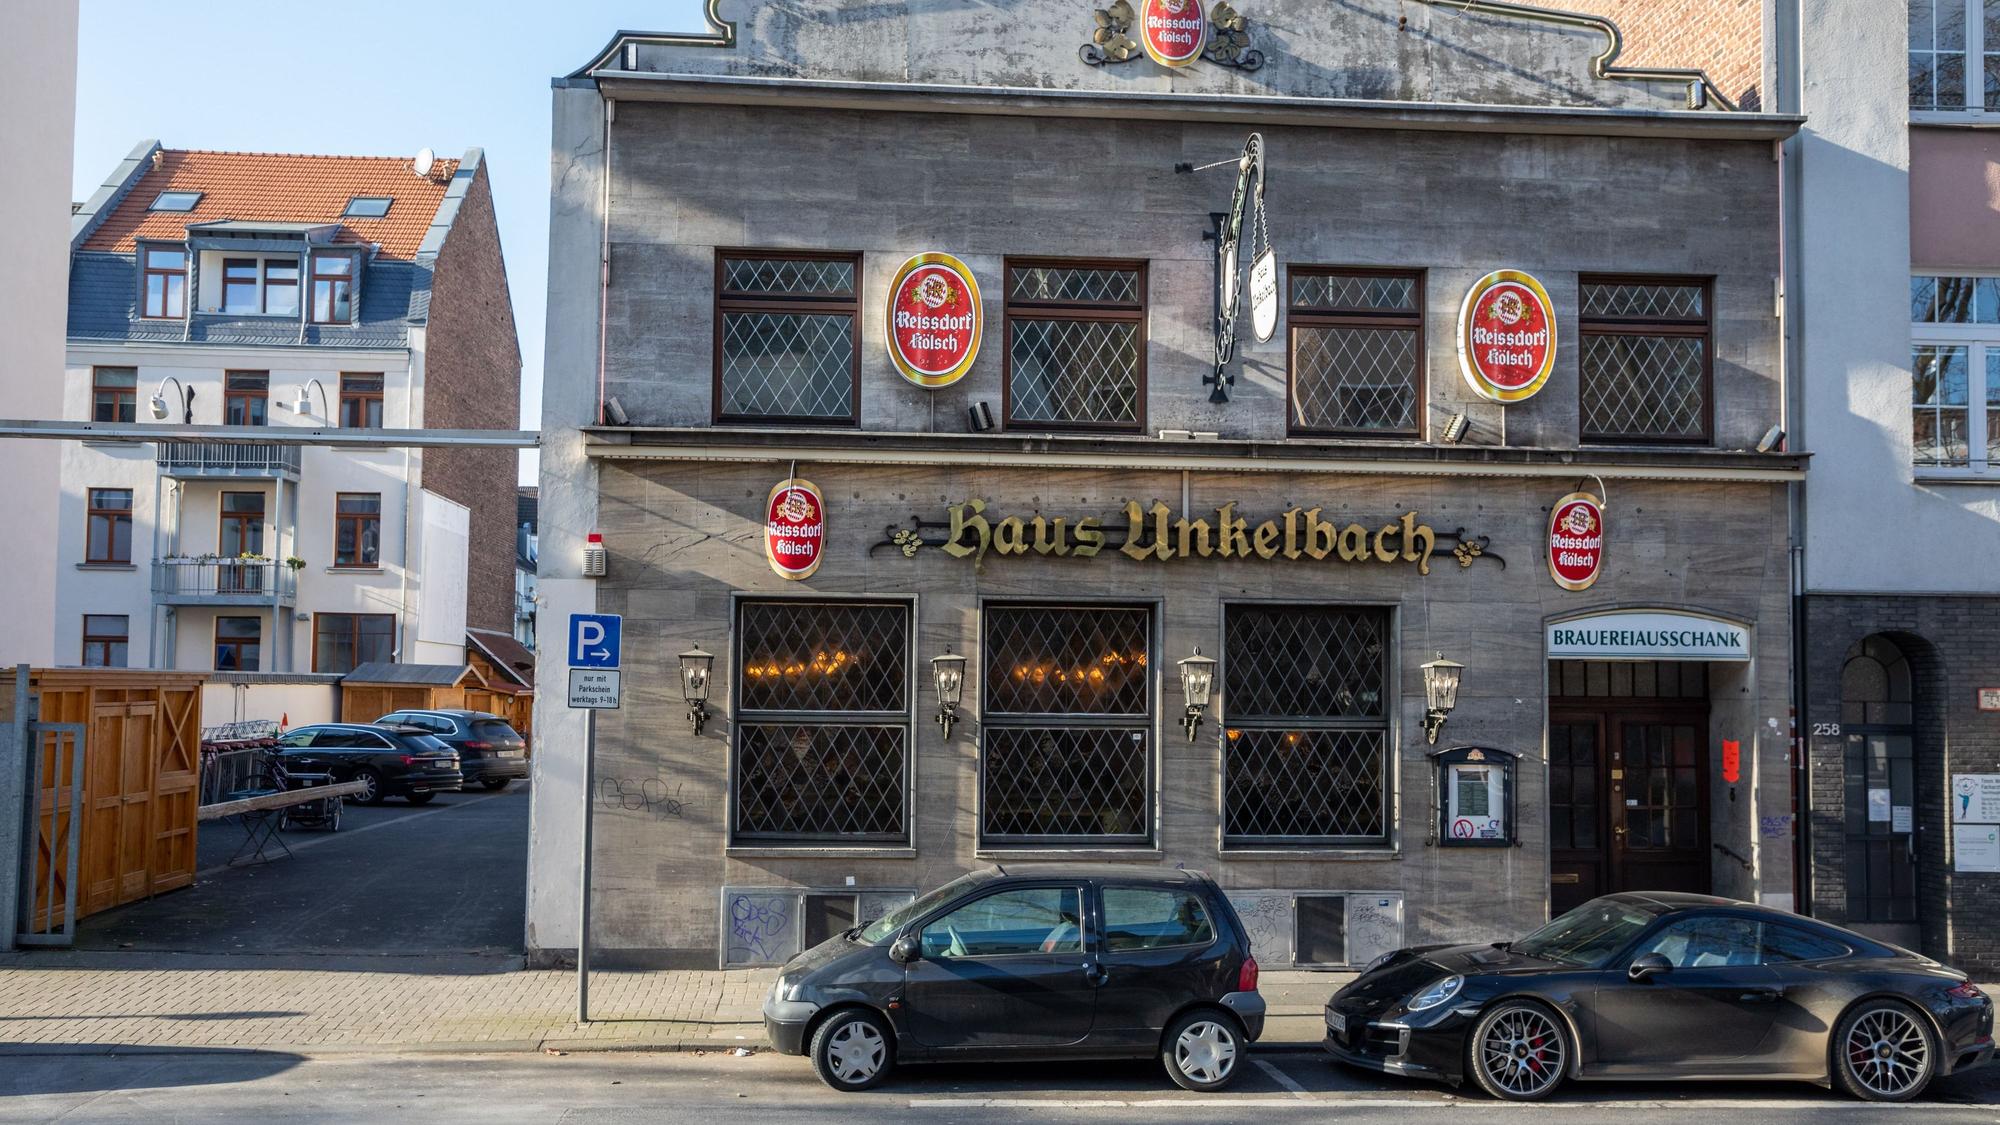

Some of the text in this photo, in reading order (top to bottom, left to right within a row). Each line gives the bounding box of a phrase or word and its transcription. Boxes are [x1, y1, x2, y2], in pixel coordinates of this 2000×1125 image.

[1147, 15, 1201, 30] Reissdorf
[1157, 30, 1192, 45] Kölsch
[896, 310, 973, 330] Reissdorf
[909, 332, 958, 354] Kölsch
[1473, 327, 1547, 346] Reissdorf
[1487, 348, 1533, 368] Kölsch
[769, 520, 822, 538] Reissdorf
[941, 500, 1436, 575] Haus Unkelbach
[776, 539, 813, 557] Kölsch
[1552, 533, 1601, 550] Reissdorf
[1558, 550, 1594, 568] Kölsch
[577, 620, 605, 660] P
[1553, 629, 1741, 648] BRAUEREIAUSSCHANK
[579, 685, 611, 693] Parkschein
[572, 697, 598, 705] werktags
[1812, 723, 1840, 736] 258
